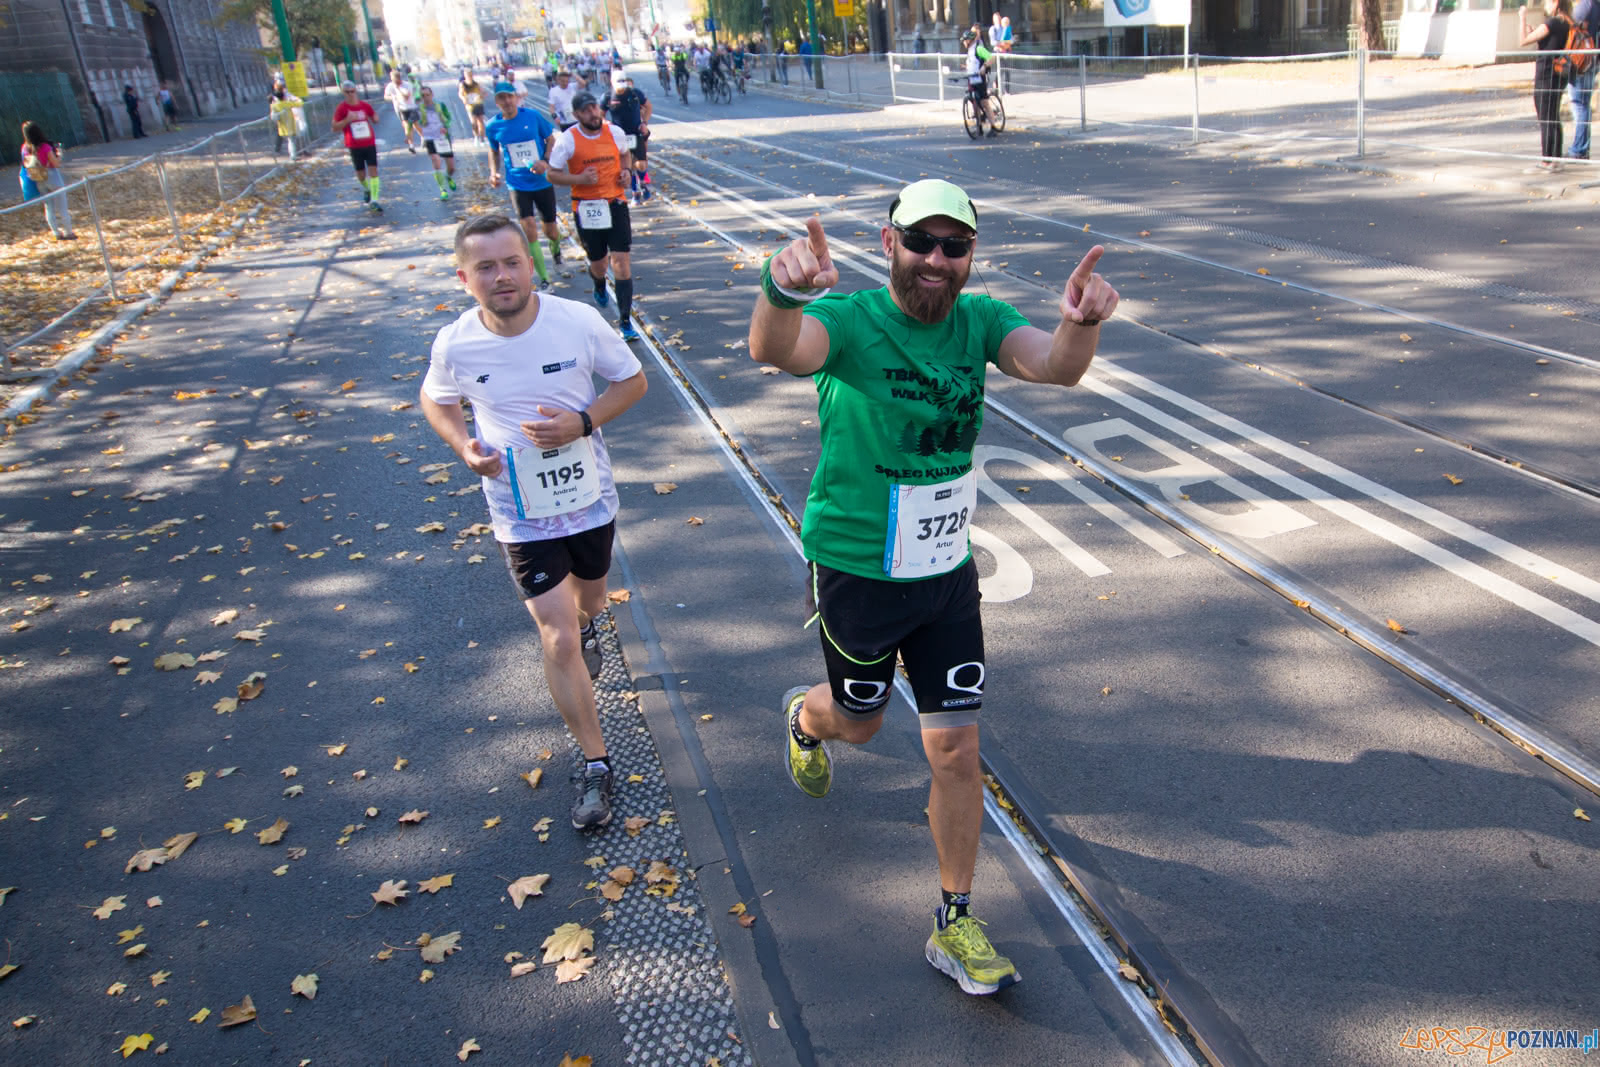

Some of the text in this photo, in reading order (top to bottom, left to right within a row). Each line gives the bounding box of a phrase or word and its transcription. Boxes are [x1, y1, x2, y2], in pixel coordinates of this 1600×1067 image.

[586, 209, 602, 218] 526
[536, 460, 584, 488] 1195
[553, 486, 578, 496] Andrzej
[916, 506, 968, 540] 3728
[935, 541, 954, 549] Artur
